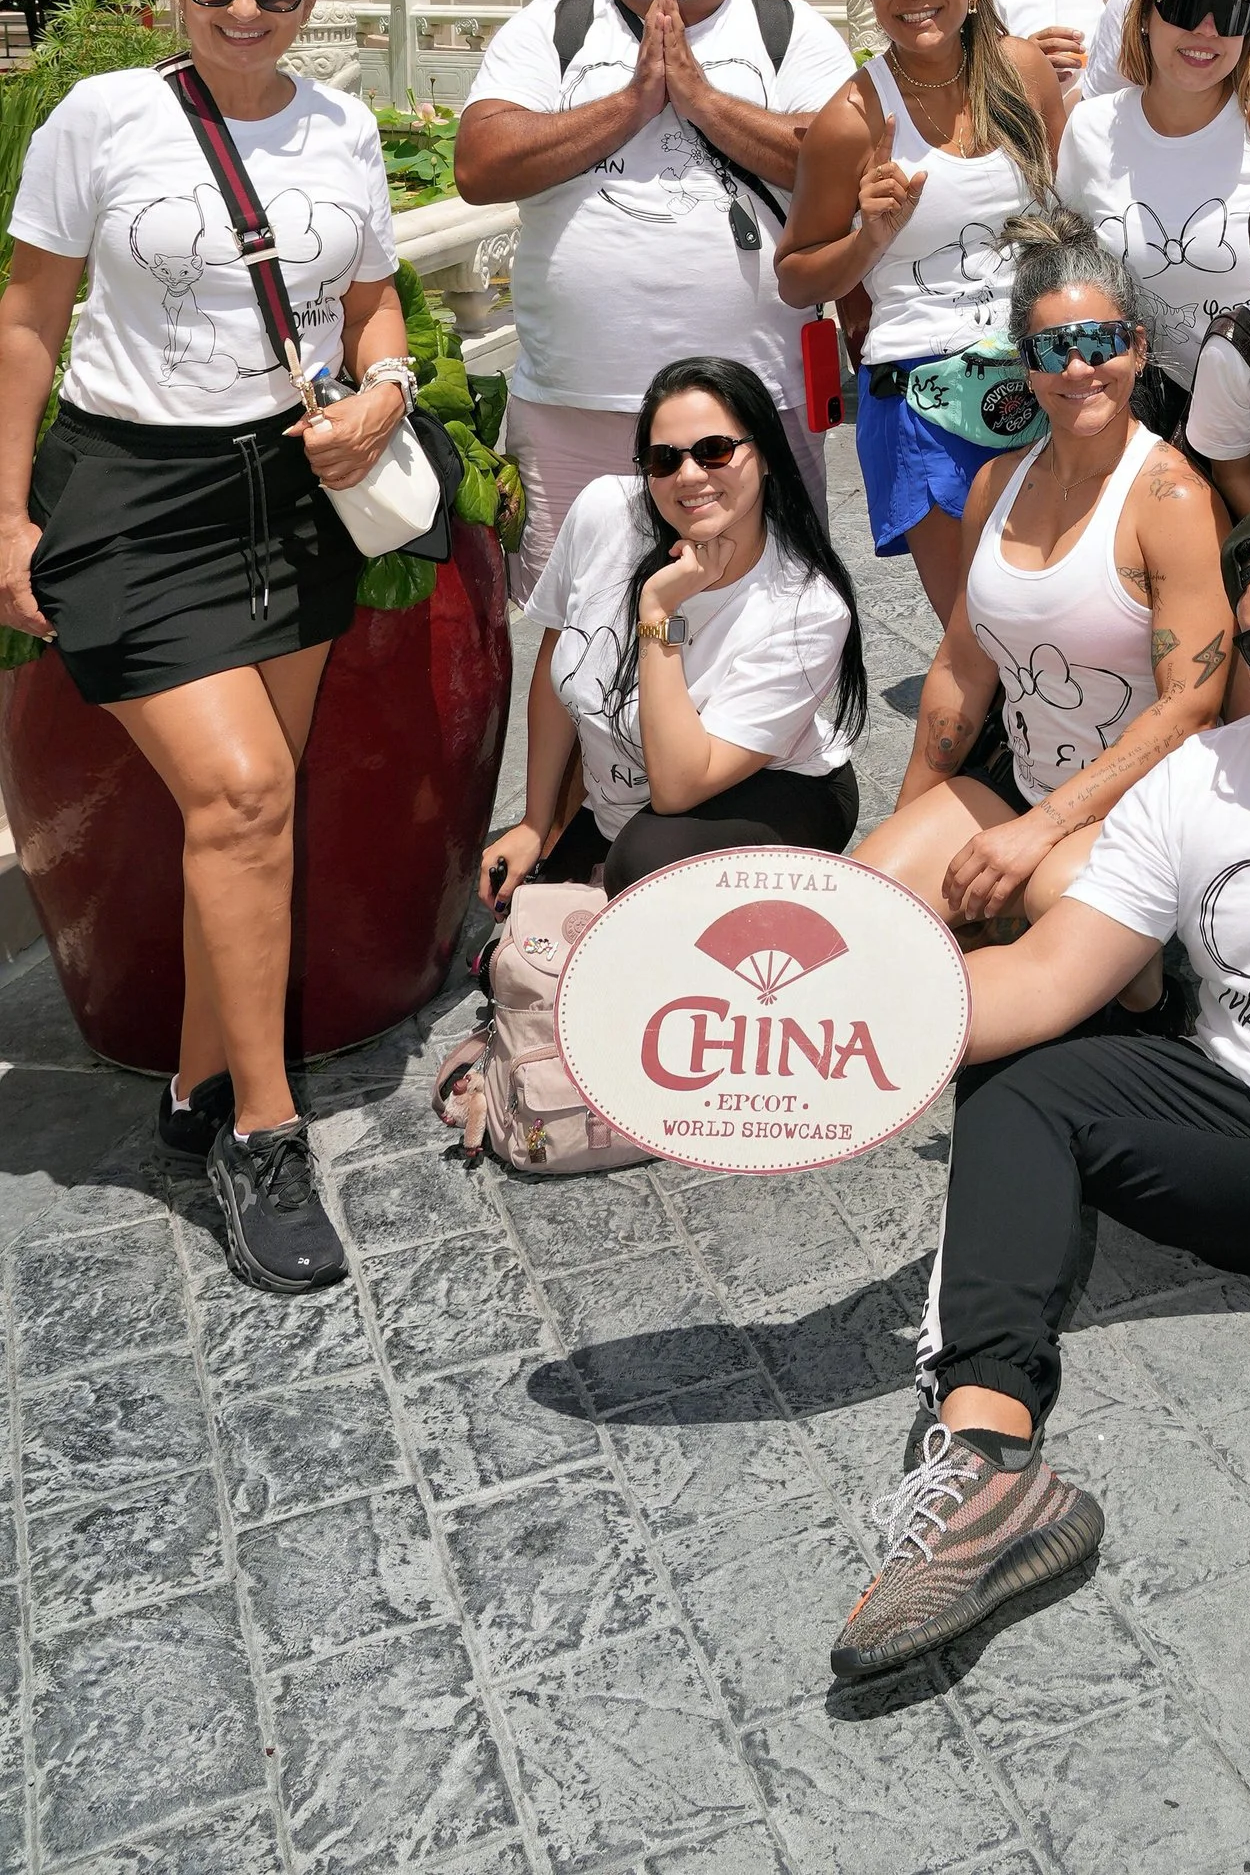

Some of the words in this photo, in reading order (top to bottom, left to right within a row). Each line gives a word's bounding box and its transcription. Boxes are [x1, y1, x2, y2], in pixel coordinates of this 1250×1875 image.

[983, 381, 1025, 412] STITCH
[1005, 408, 1033, 432] 626
[715, 870, 838, 892] ARRIVAL
[641, 995, 901, 1091] CHINA
[716, 1093, 797, 1113] EPCOT
[662, 1119, 736, 1138] WORLD
[741, 1121, 853, 1141] SHOWCASE
